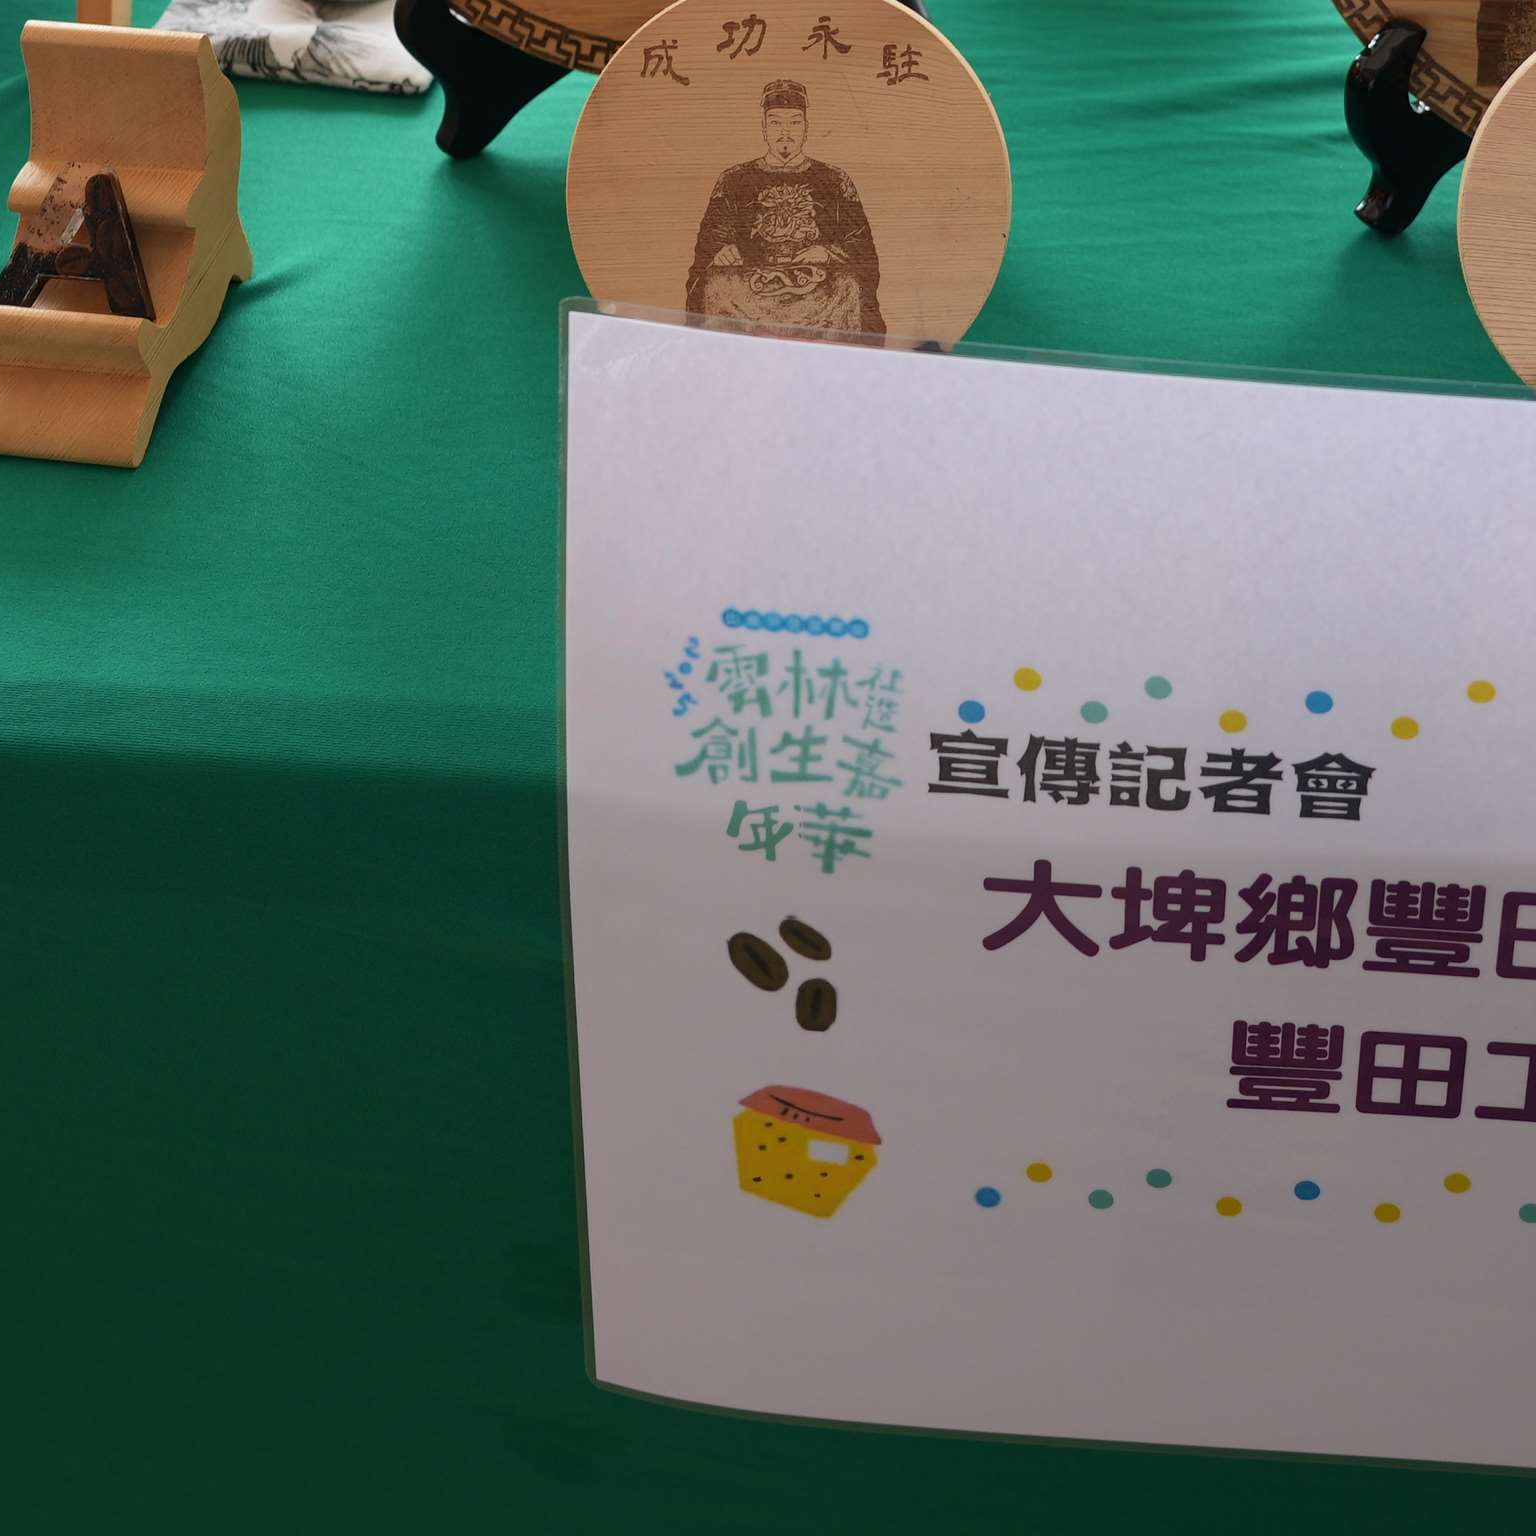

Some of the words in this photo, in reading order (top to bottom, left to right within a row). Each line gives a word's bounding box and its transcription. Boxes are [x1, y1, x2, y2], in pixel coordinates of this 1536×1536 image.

[927, 729, 1377, 822] 宣傳記者會
[725, 799, 873, 875] 年華
